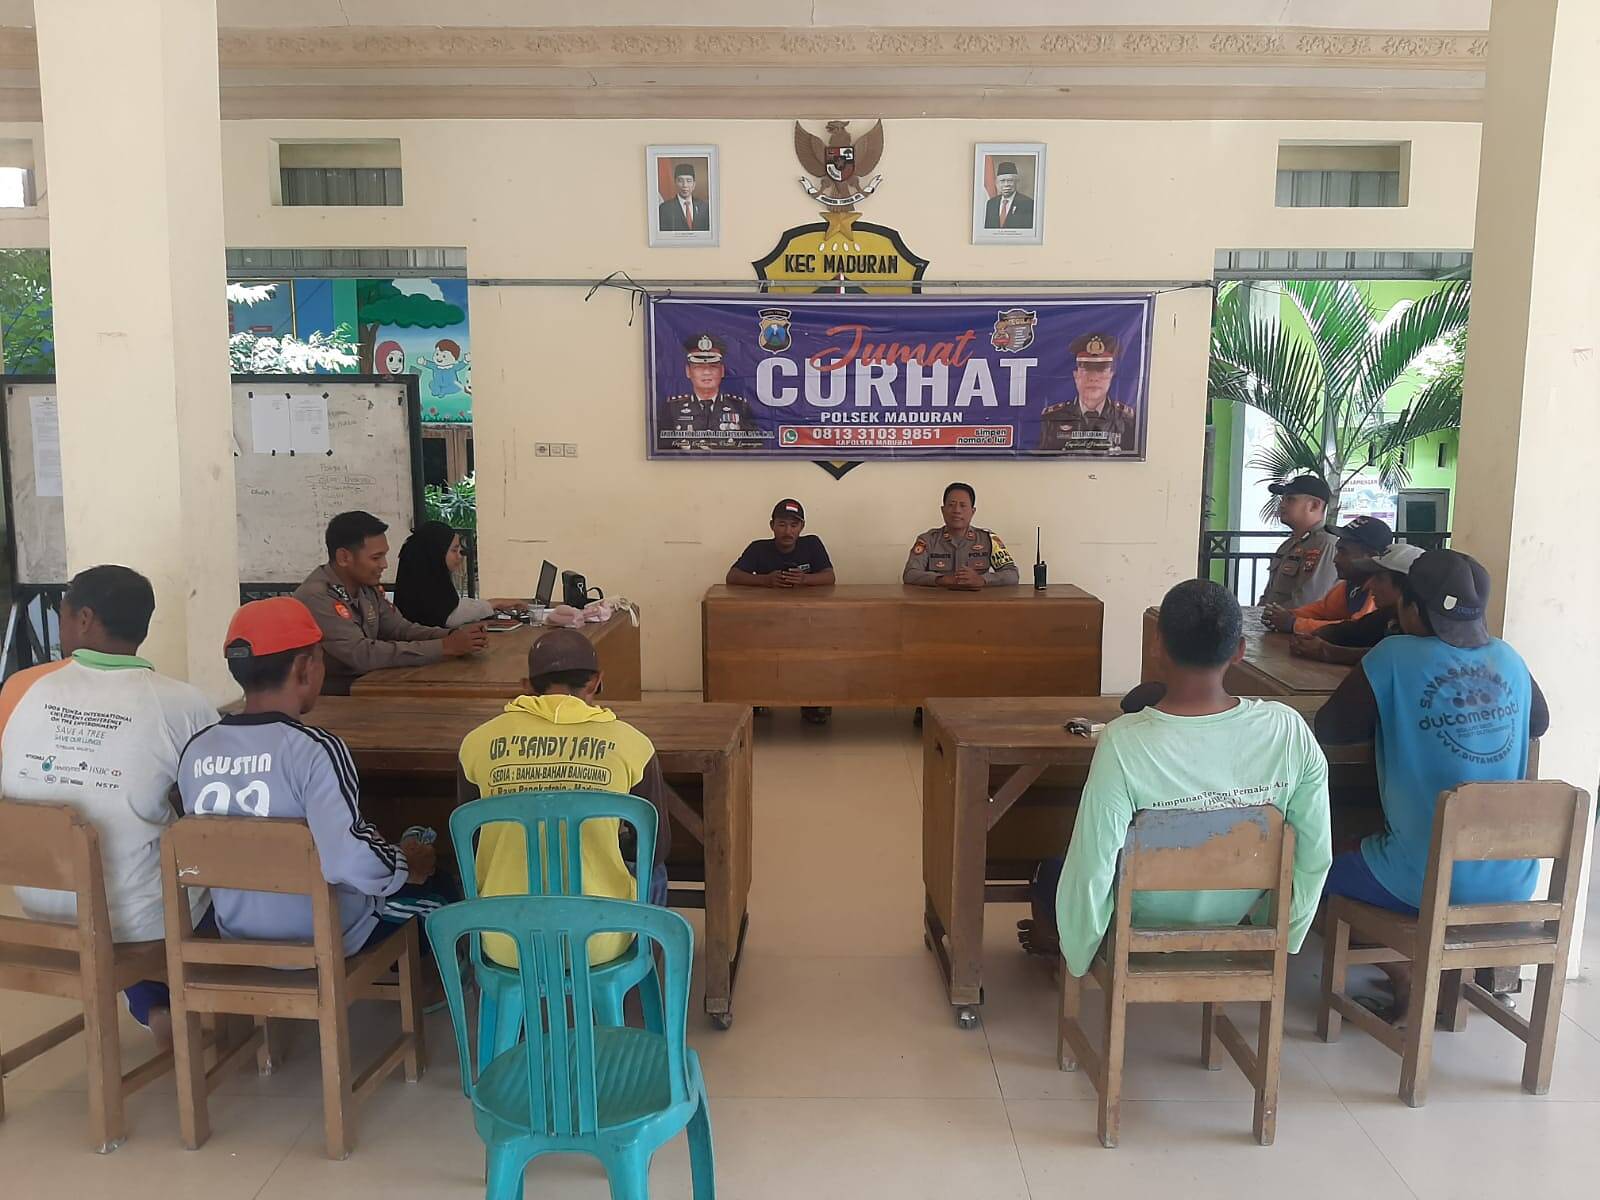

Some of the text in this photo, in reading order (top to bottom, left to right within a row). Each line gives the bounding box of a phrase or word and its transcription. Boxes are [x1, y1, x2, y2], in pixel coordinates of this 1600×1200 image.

[785, 254, 898, 273] KEC MADURAN
[810, 324, 976, 372] Jumat
[756, 357, 1038, 407] CURHAT
[820, 411, 963, 423] POLSEK MADURAN
[812, 428, 941, 439] 0813 3103 9851
[1418, 700, 1520, 731] dutamerpati
[56, 725, 105, 739] SAVE A TREE
[490, 736, 510, 760] UD.
[194, 752, 272, 778] AGUSTIN
[493, 768, 510, 783] SEDIA
[516, 766, 566, 780] BAHAN-BAHAN
[568, 766, 607, 782] BANGUNAN
[1152, 794, 1203, 808] Himpunan
